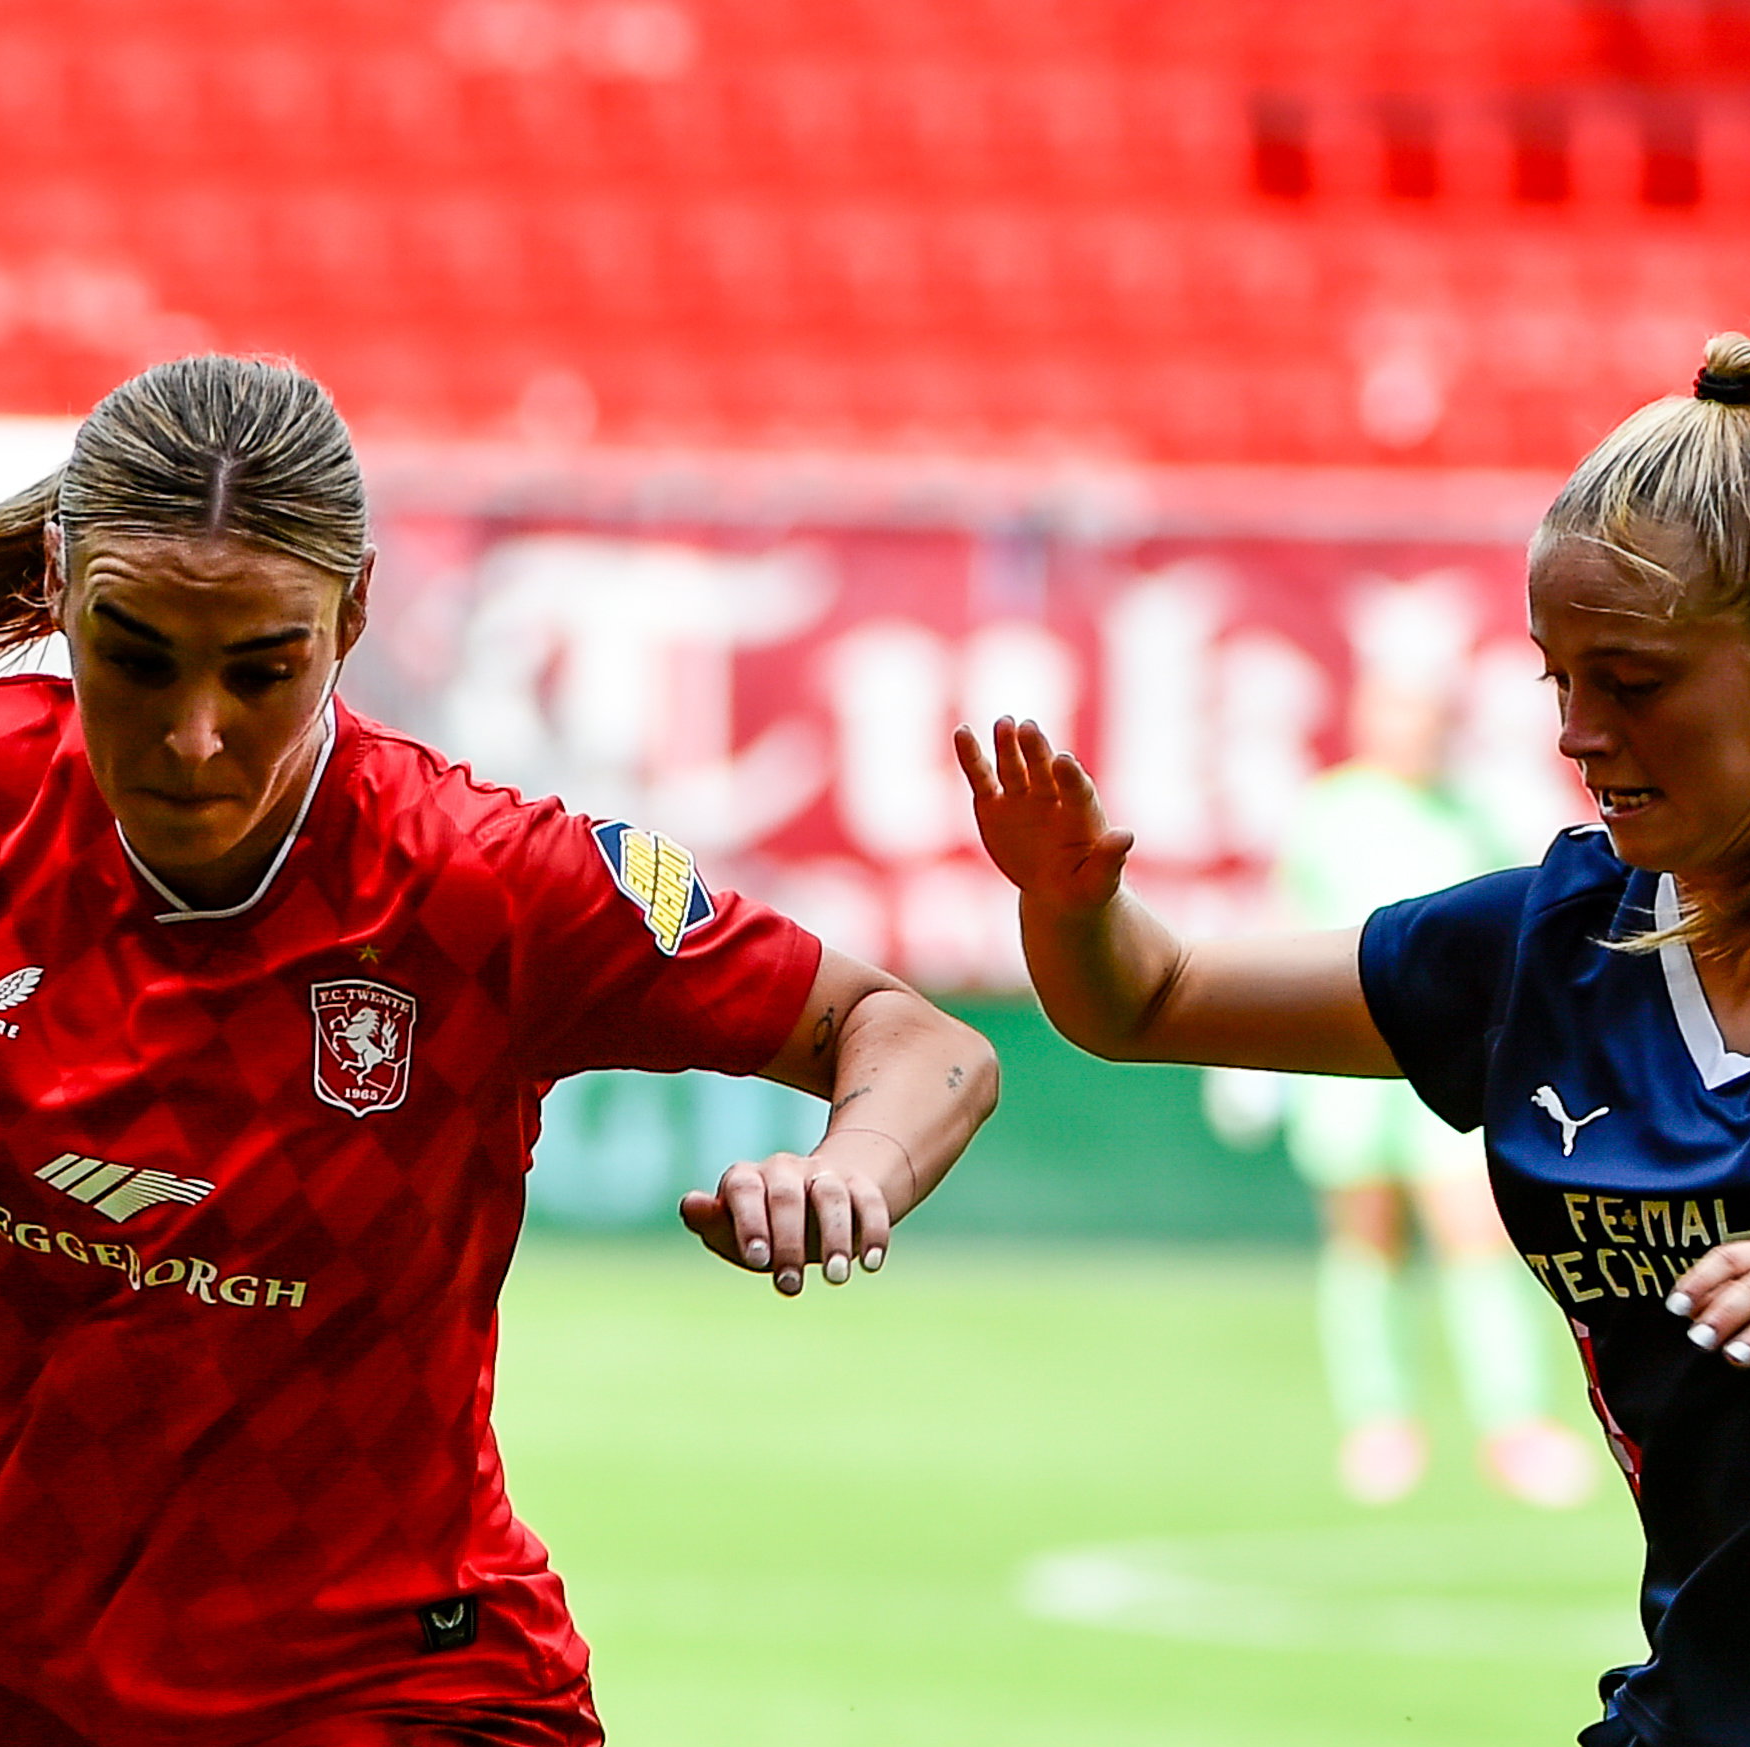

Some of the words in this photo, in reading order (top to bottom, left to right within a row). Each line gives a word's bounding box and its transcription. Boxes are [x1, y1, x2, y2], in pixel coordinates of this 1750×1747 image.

[319, 989, 346, 1003] F.C.
[347, 988, 411, 1013] TWENTE
[344, 1087, 379, 1101] 1965
